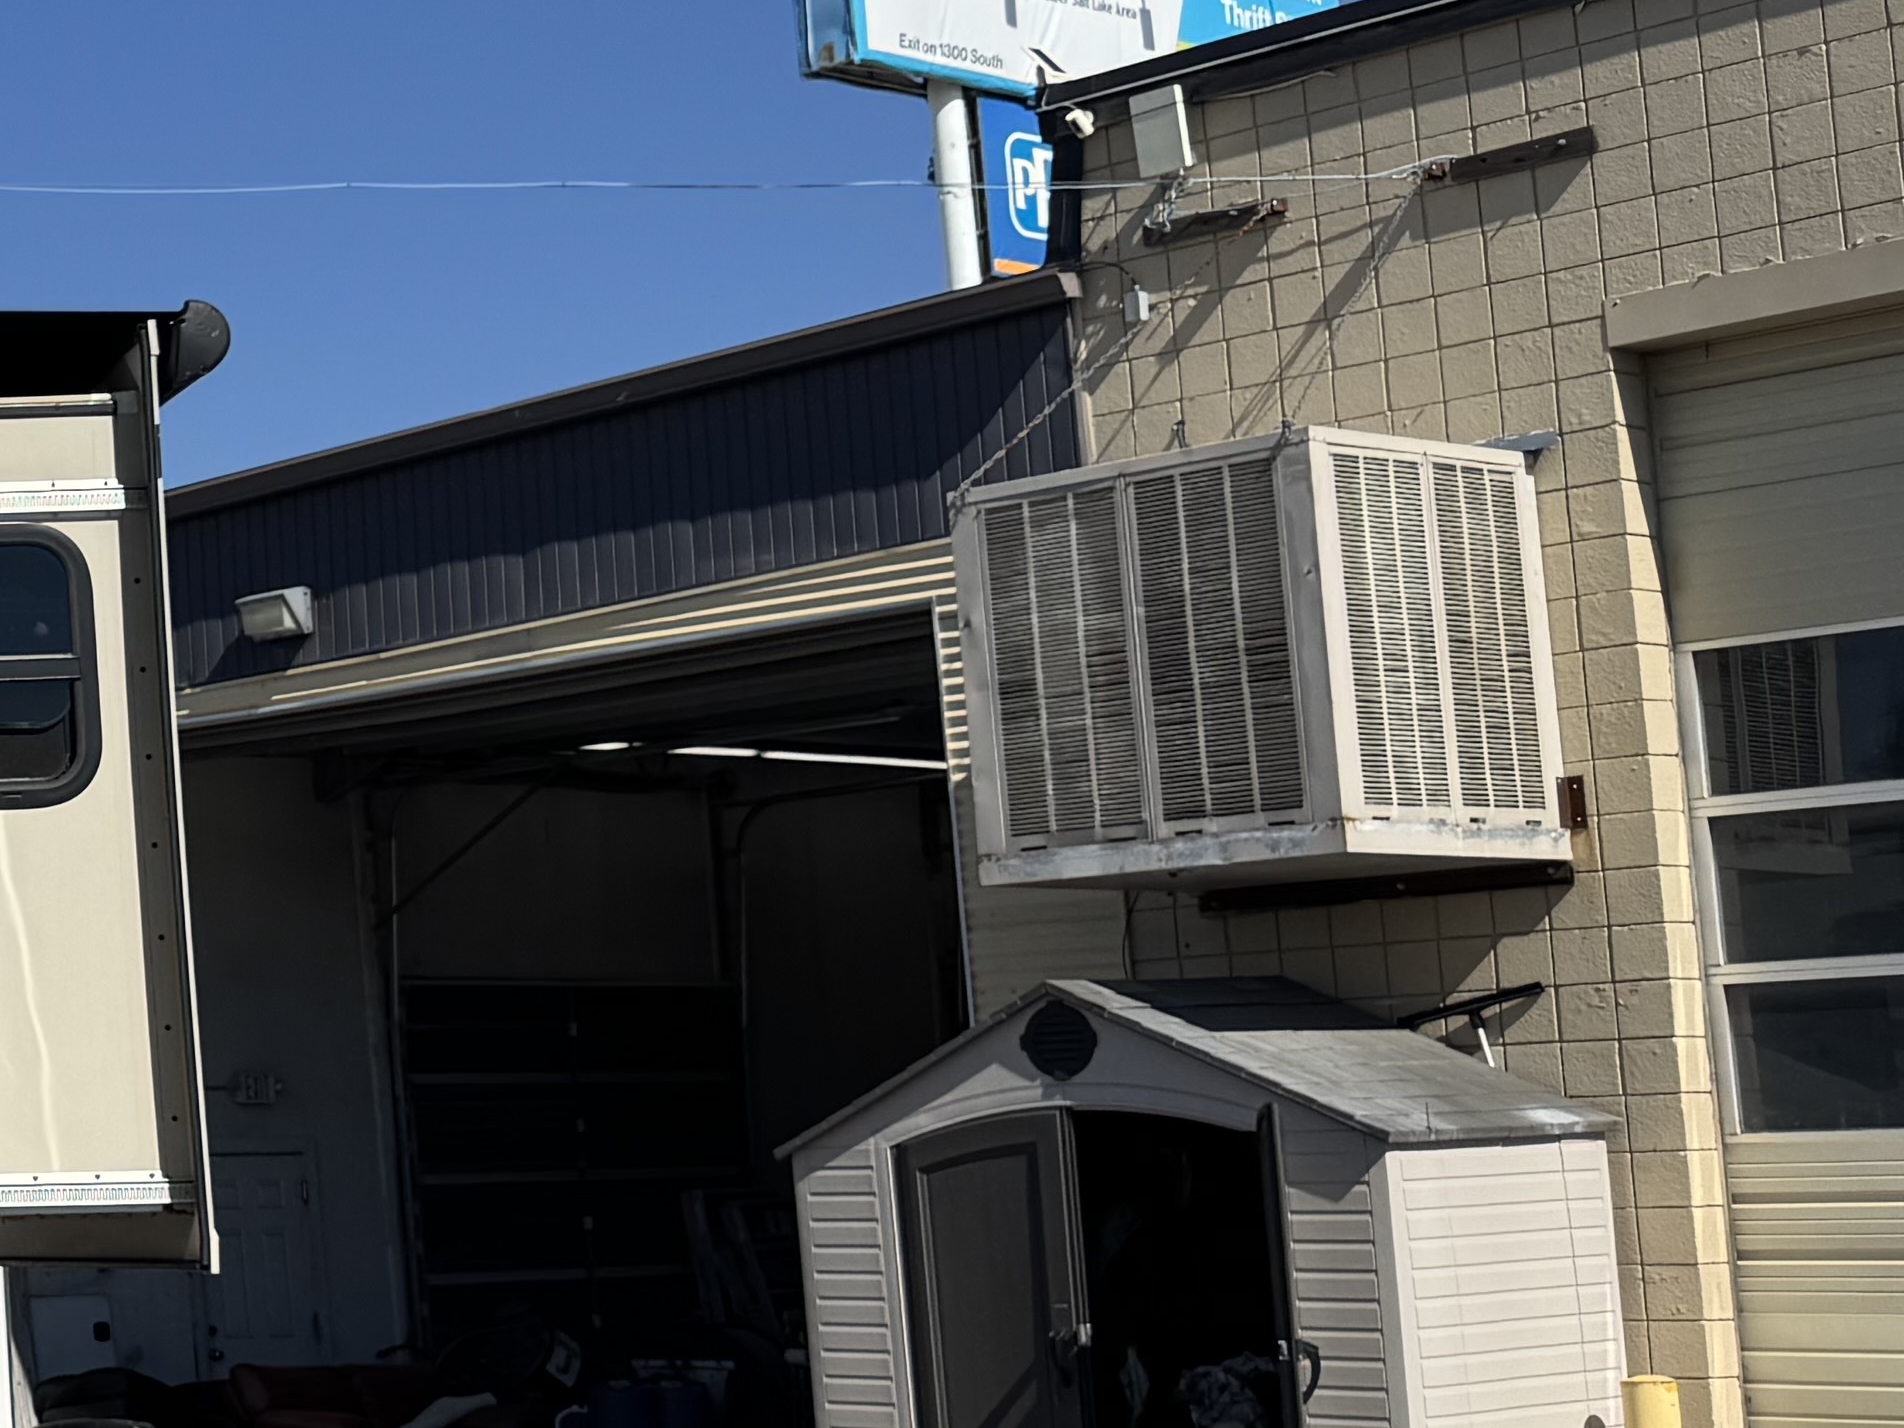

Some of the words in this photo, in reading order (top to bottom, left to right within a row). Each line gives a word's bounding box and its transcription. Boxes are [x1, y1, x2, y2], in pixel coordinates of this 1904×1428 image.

[1115, 2, 1137, 20] Area
[899, 33, 920, 52] Exit
[922, 42, 937, 56] on
[939, 42, 968, 61] 1300
[970, 48, 1004, 69] South
